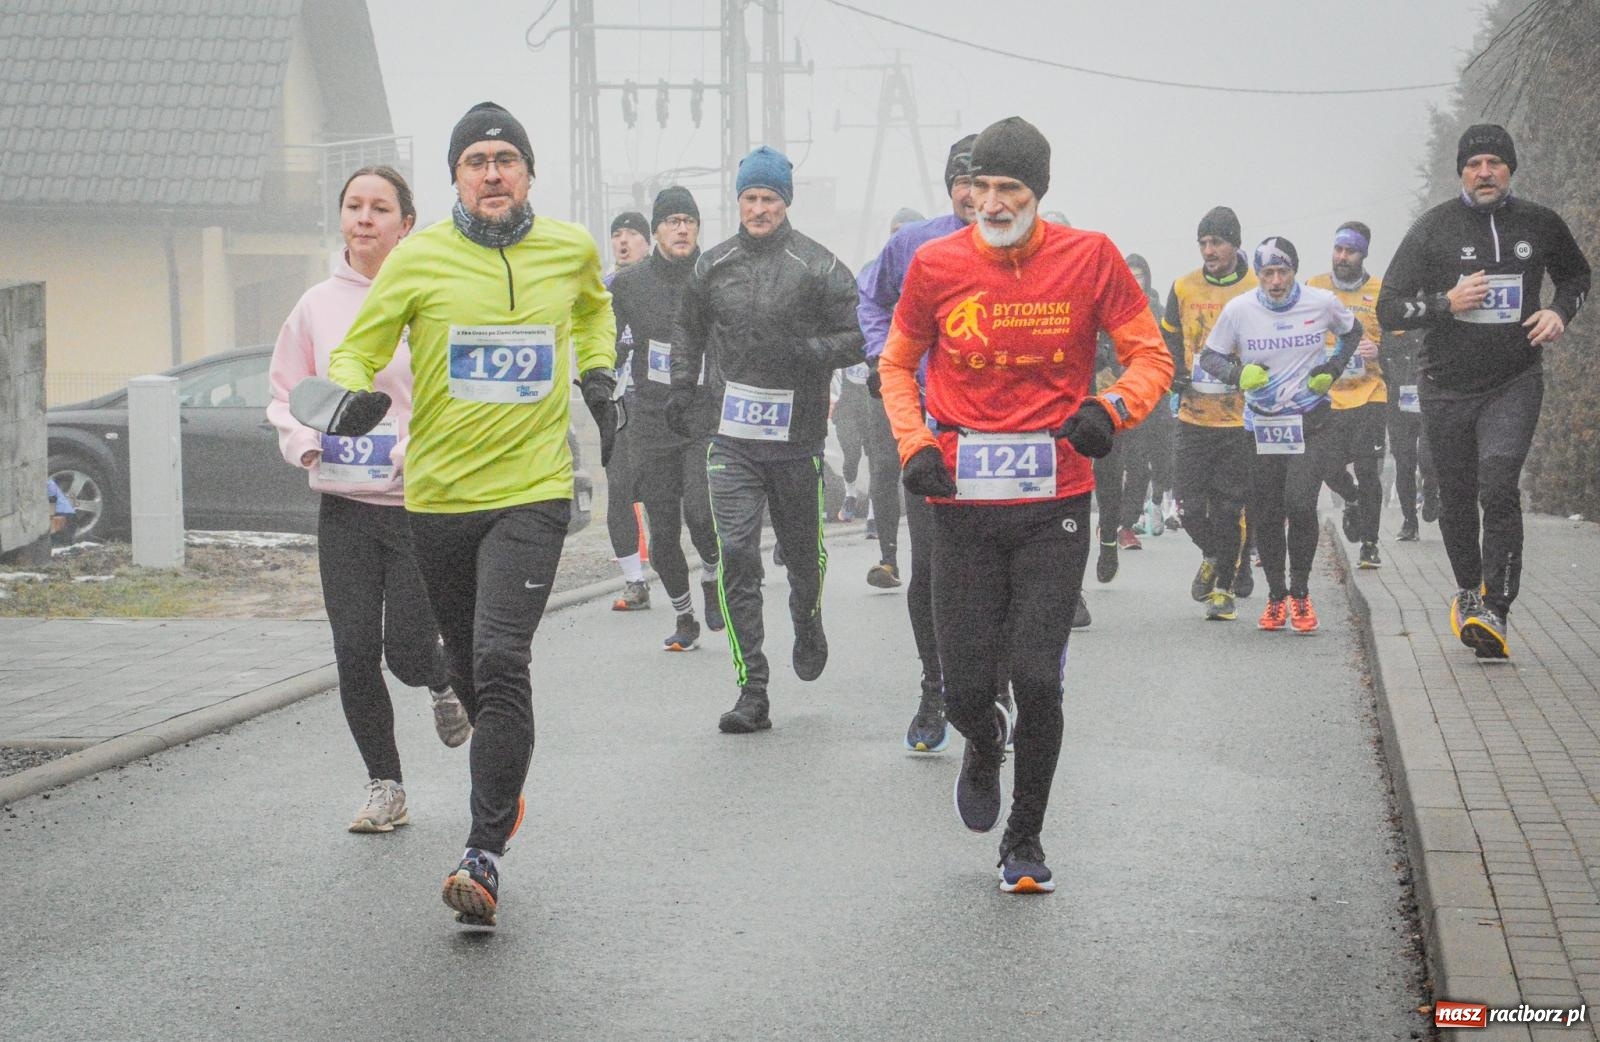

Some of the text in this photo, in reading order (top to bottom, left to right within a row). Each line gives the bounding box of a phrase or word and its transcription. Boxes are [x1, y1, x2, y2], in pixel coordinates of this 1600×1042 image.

[486, 128, 502, 136] 4F
[992, 302, 1070, 317] BYTOMSKI
[992, 315, 1071, 330] półmaraton
[1247, 332, 1321, 351] RUNNERS
[468, 347, 537, 379] 199
[733, 400, 779, 425] 184
[1263, 426, 1295, 443] 194
[338, 436, 374, 464] 39
[974, 446, 1039, 477] 124
